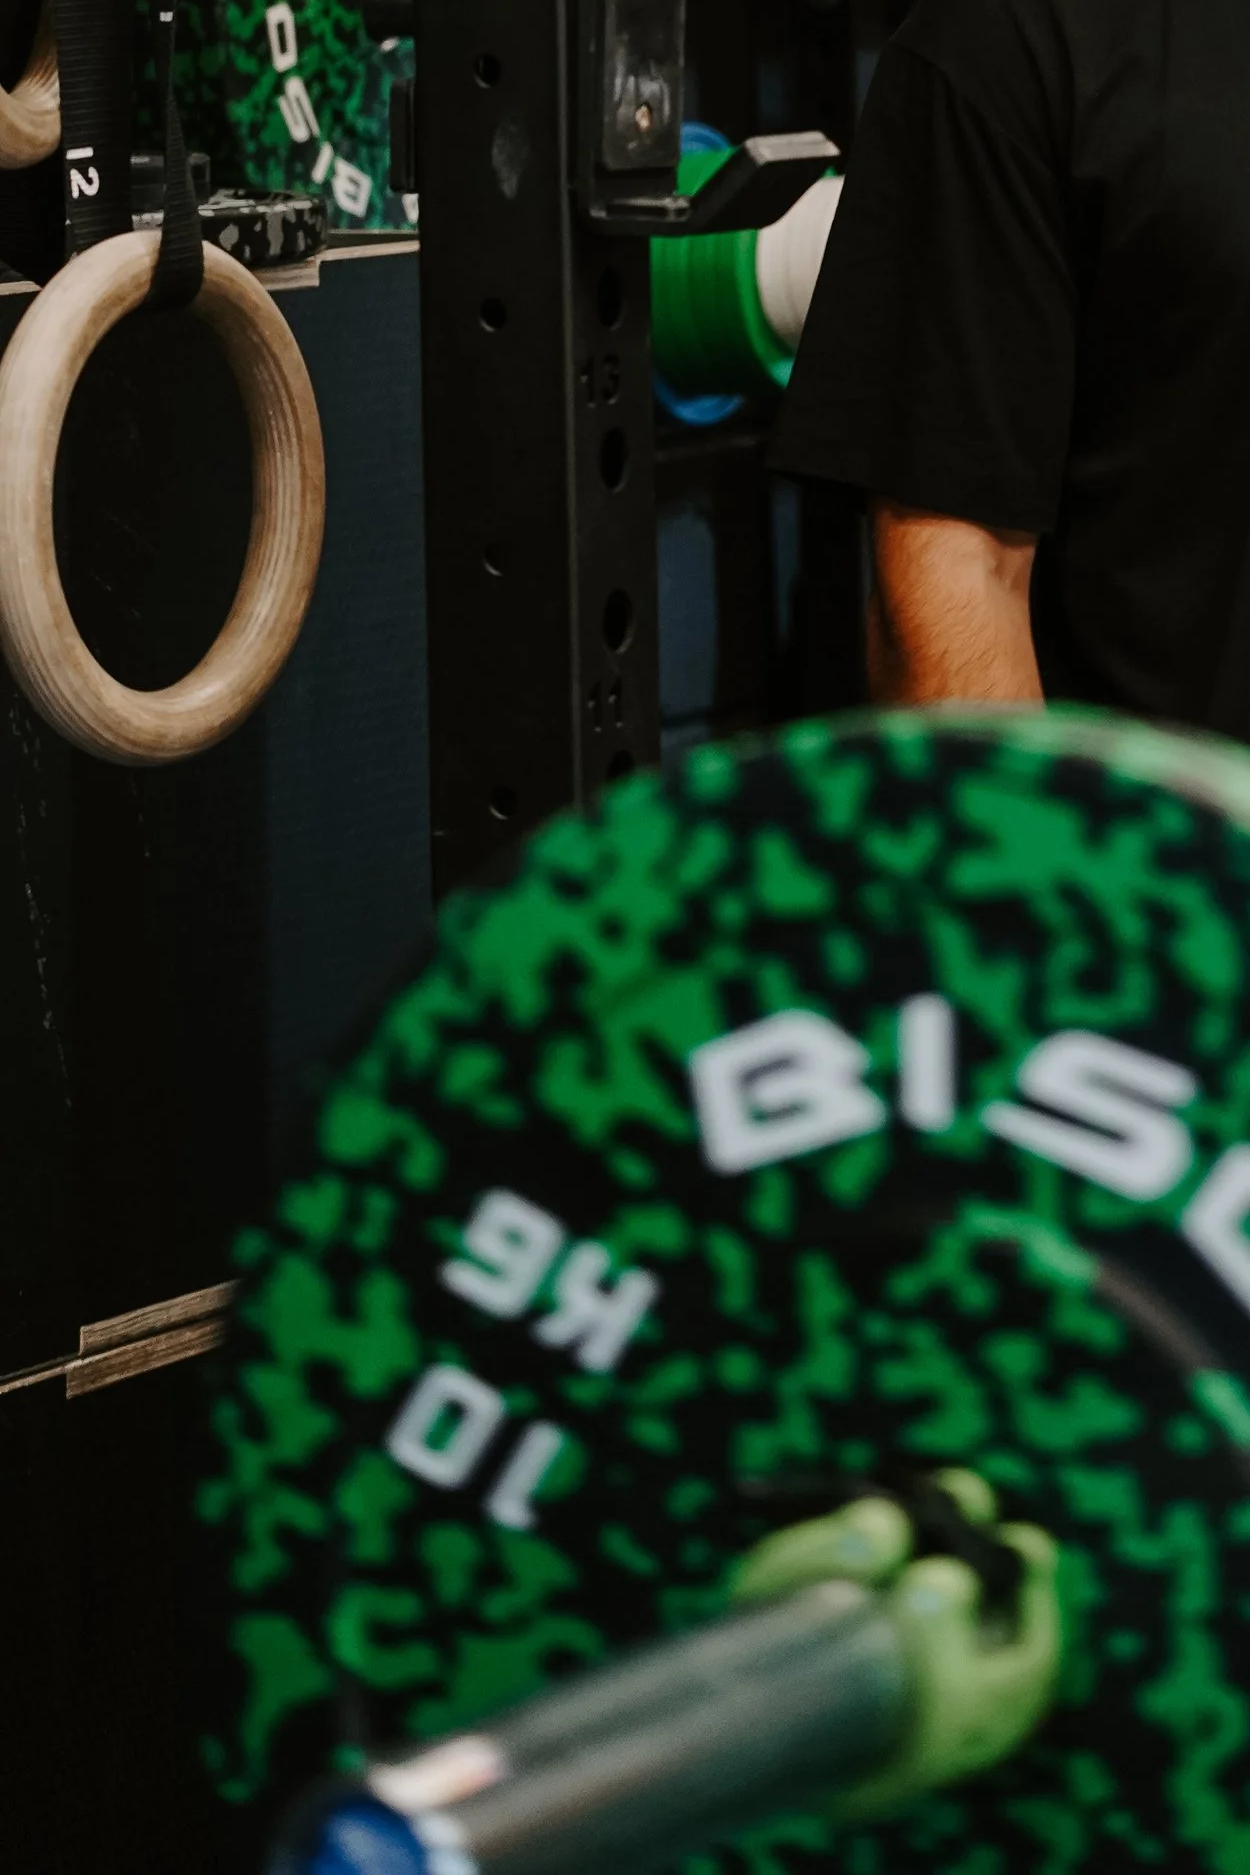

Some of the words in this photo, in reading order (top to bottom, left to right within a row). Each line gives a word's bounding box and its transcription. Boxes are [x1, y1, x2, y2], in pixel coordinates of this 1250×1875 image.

[580, 354, 621, 406] 13
[437, 1185, 663, 1375] KG
[384, 1361, 565, 1532] 10
